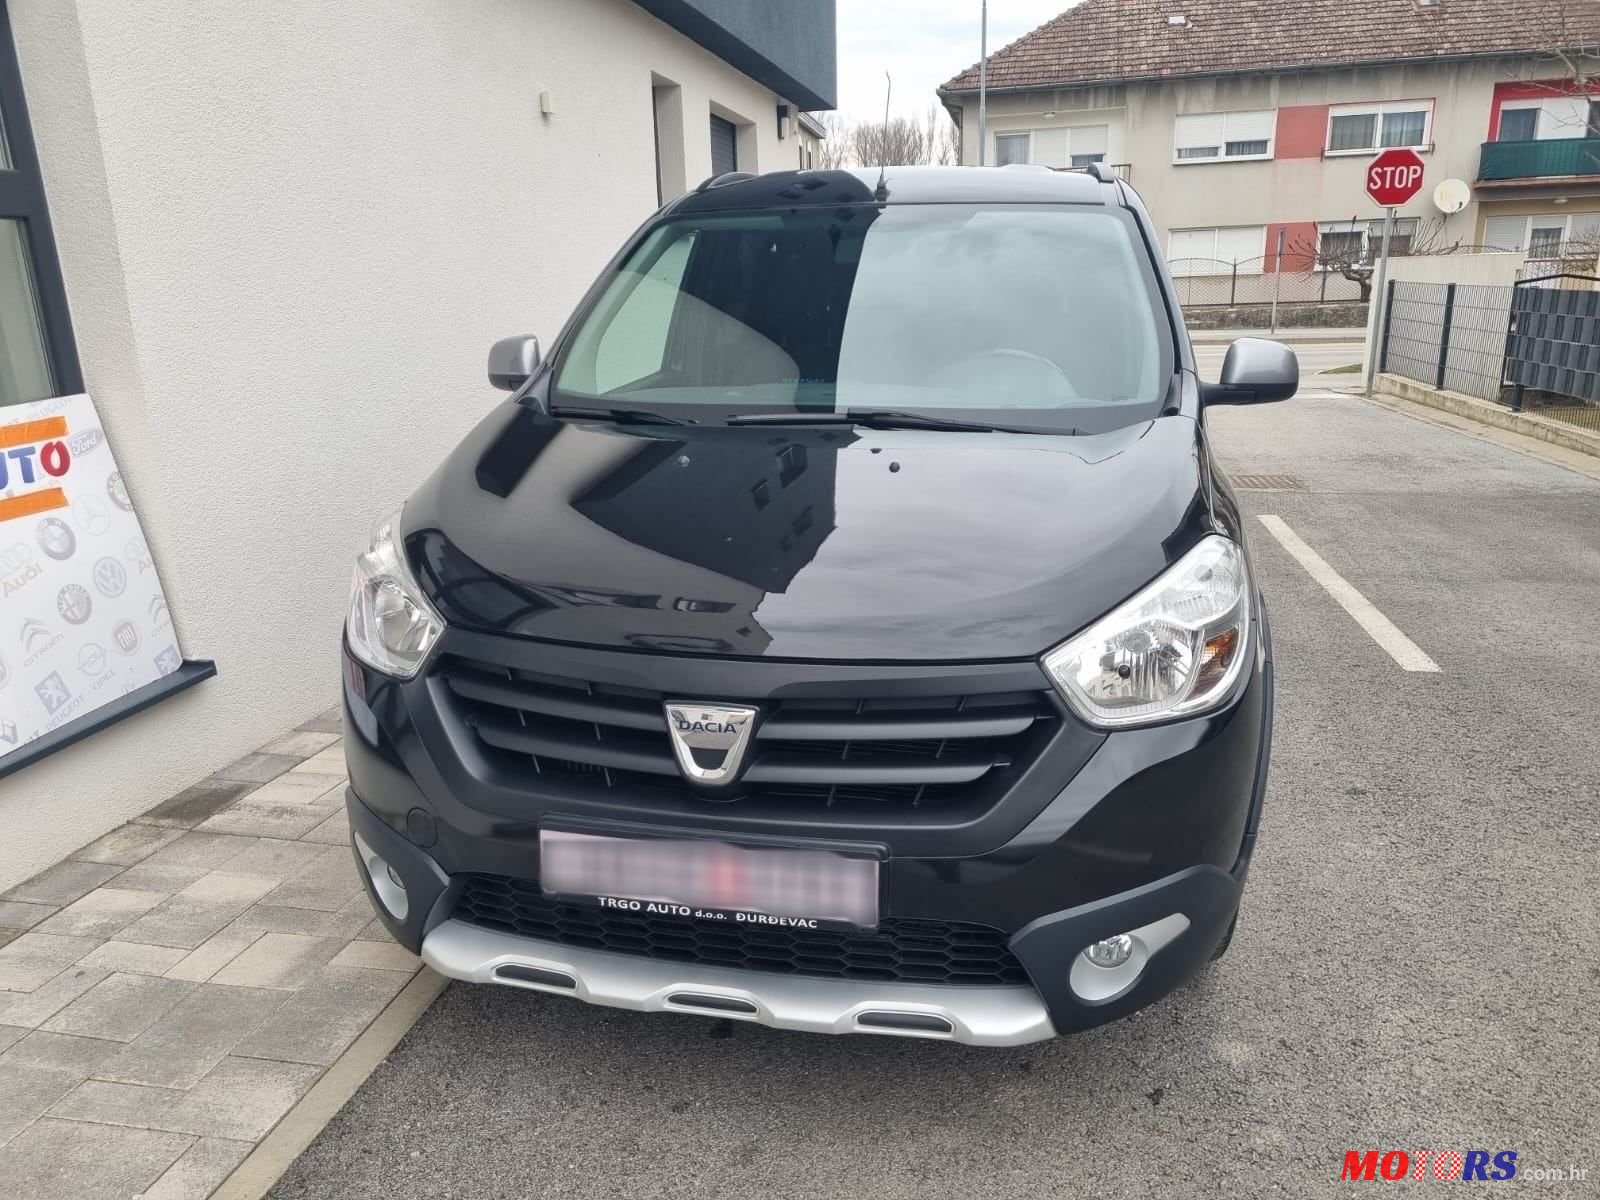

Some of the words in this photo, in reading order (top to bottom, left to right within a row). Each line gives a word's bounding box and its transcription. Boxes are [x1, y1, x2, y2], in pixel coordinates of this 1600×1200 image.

[1370, 165, 1421, 190] STOP
[71, 436, 98, 457] Ford
[2, 562, 43, 597] Audi
[92, 670, 118, 691] OPEL
[678, 719, 738, 734] DACIA
[597, 896, 641, 910] TRGO
[646, 902, 691, 917] AUTO
[695, 909, 728, 921] d.o.o.
[735, 912, 818, 929] ĐURĐEVAC
